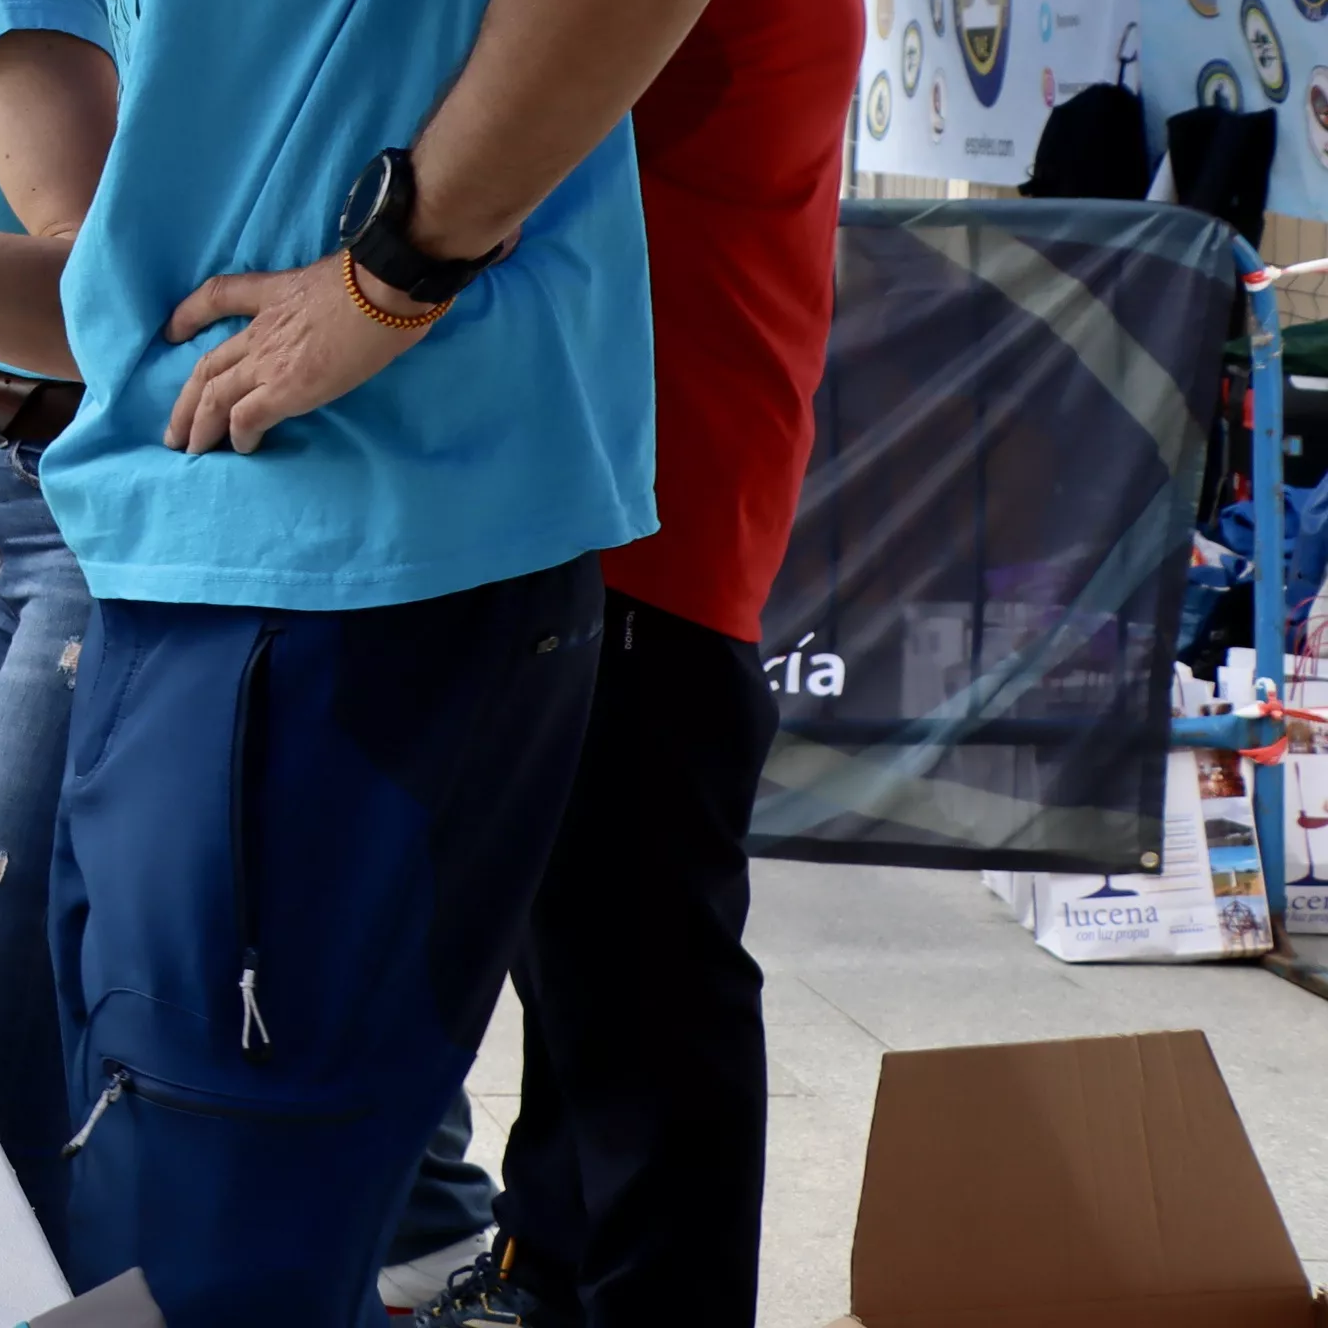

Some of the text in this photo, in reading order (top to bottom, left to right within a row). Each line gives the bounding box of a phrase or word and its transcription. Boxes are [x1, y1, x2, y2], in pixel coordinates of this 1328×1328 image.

[1063, 902, 1160, 928] lucena
[1075, 927, 1150, 943] con luz propia
